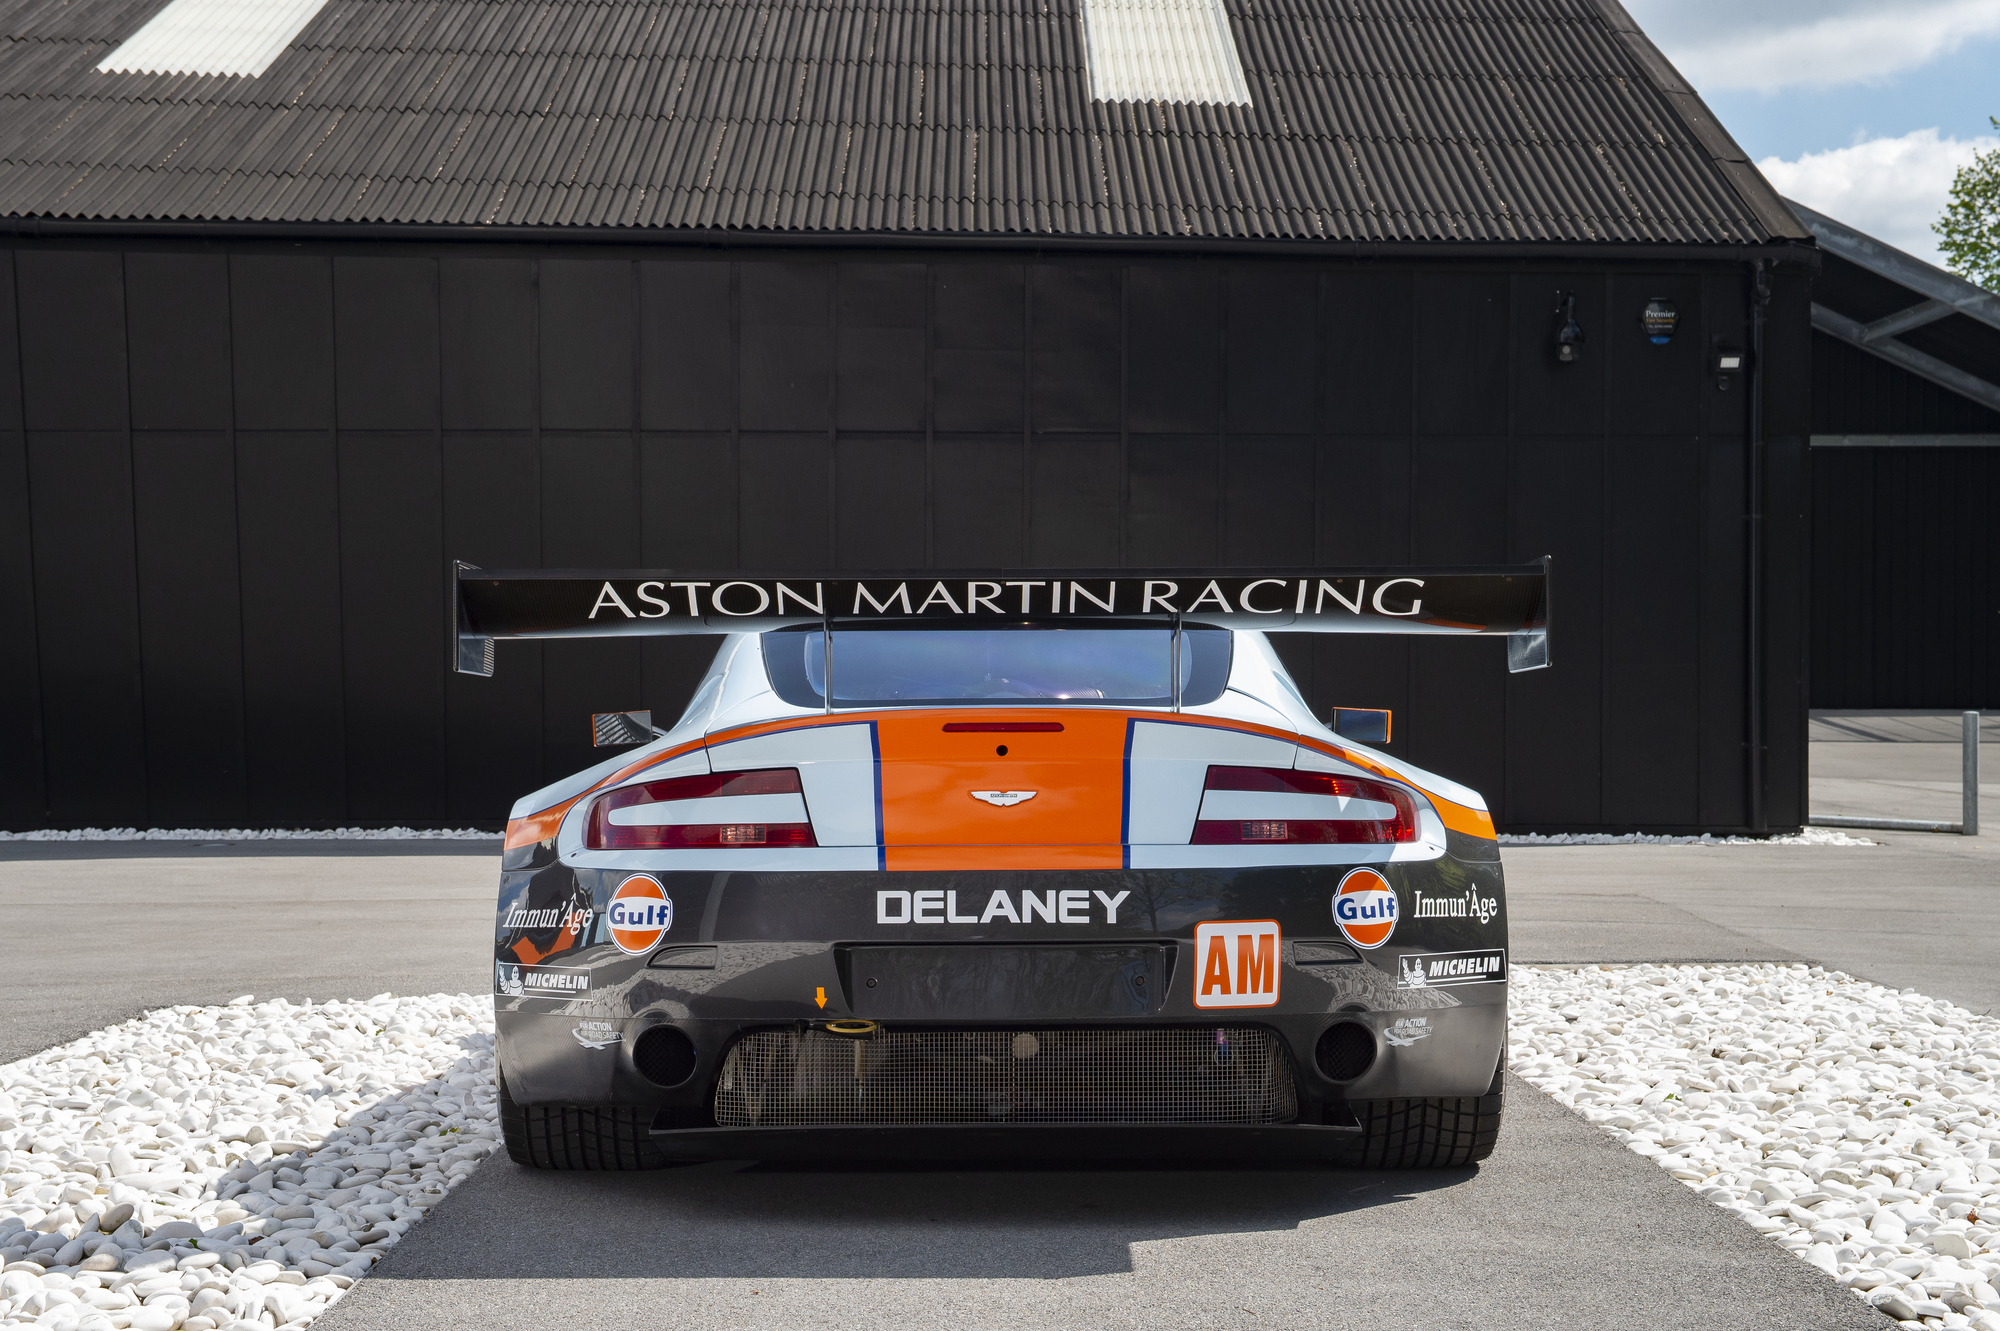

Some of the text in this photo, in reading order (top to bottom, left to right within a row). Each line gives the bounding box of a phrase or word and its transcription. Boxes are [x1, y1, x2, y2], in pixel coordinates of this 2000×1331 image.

[1645, 310, 1676, 318] Premier
[588, 578, 1425, 619] ASTON MARTIN RACING
[609, 902, 669, 926] Gulf
[876, 889, 1132, 924] DELANEY
[1336, 897, 1396, 921] Gulf
[1200, 933, 1275, 996] AM
[1428, 956, 1501, 977] MICHELIN
[523, 972, 589, 990] MICHELIN
[588, 1021, 612, 1031] ACTION
[1404, 1017, 1427, 1028] ACTION
[1416, 1026, 1433, 1034] SAFETY
[603, 1031, 624, 1039] SAFETY
